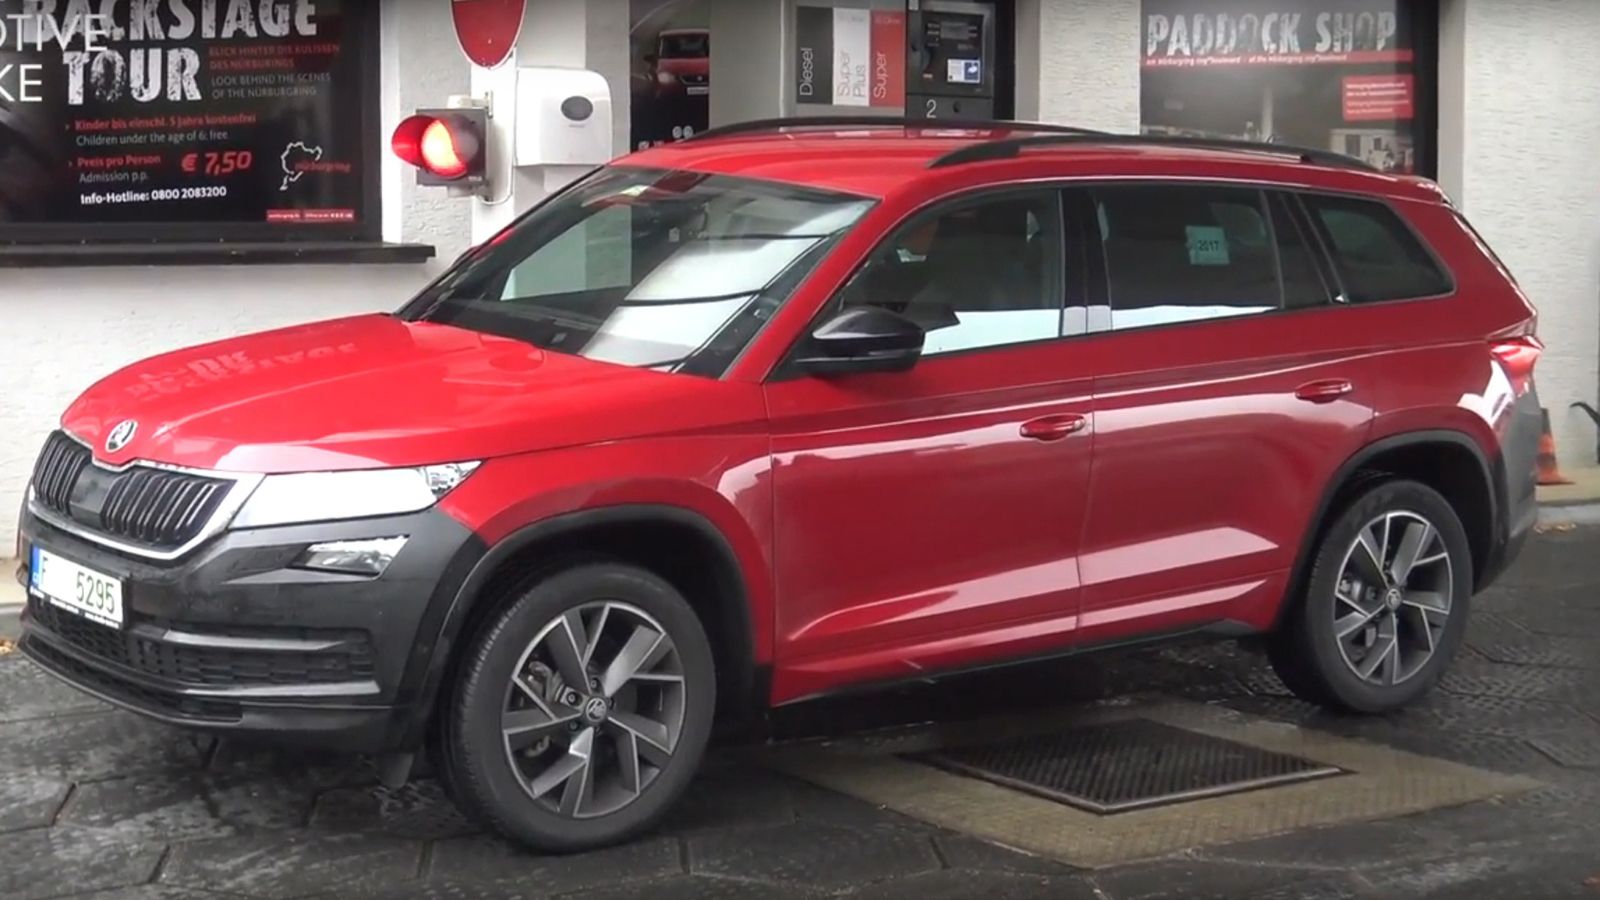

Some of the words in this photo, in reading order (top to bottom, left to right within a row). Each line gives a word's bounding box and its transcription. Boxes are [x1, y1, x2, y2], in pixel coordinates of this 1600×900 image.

[1146, 12, 1300, 56] PADDOCK
[1315, 11, 1396, 52] SHOP
[63, 48, 202, 104] TOUR
[211, 76, 237, 87] LOOK
[240, 74, 275, 84] BEHIND
[278, 74, 294, 83] THE
[297, 72, 331, 82] SCENES
[800, 47, 813, 96] Diesel
[838, 51, 852, 97] Super
[853, 64, 866, 98] Plus
[874, 52, 889, 98] Super
[212, 90, 224, 100] OF
[228, 88, 244, 98] THE
[926, 99, 937, 119] 2
[75, 119, 110, 130] Kinder
[112, 118, 127, 129] bis
[169, 117, 175, 127] 5
[76, 133, 117, 146] Children
[120, 133, 147, 144] under
[150, 132, 165, 142] the
[168, 132, 184, 145] age
[187, 130, 198, 141] of
[210, 129, 228, 140] free
[77, 157, 105, 168] Preis
[107, 156, 123, 169] pro
[126, 154, 161, 166] Person
[181, 153, 198, 172] €
[205, 151, 252, 175] 7,50
[79, 171, 129, 183] Admission
[80, 190, 150, 205] Info-Hotline:
[151, 188, 179, 200] 0800
[181, 186, 227, 199] 2083200
[1198, 240, 1219, 251] 2017
[77, 571, 114, 614] 5295
